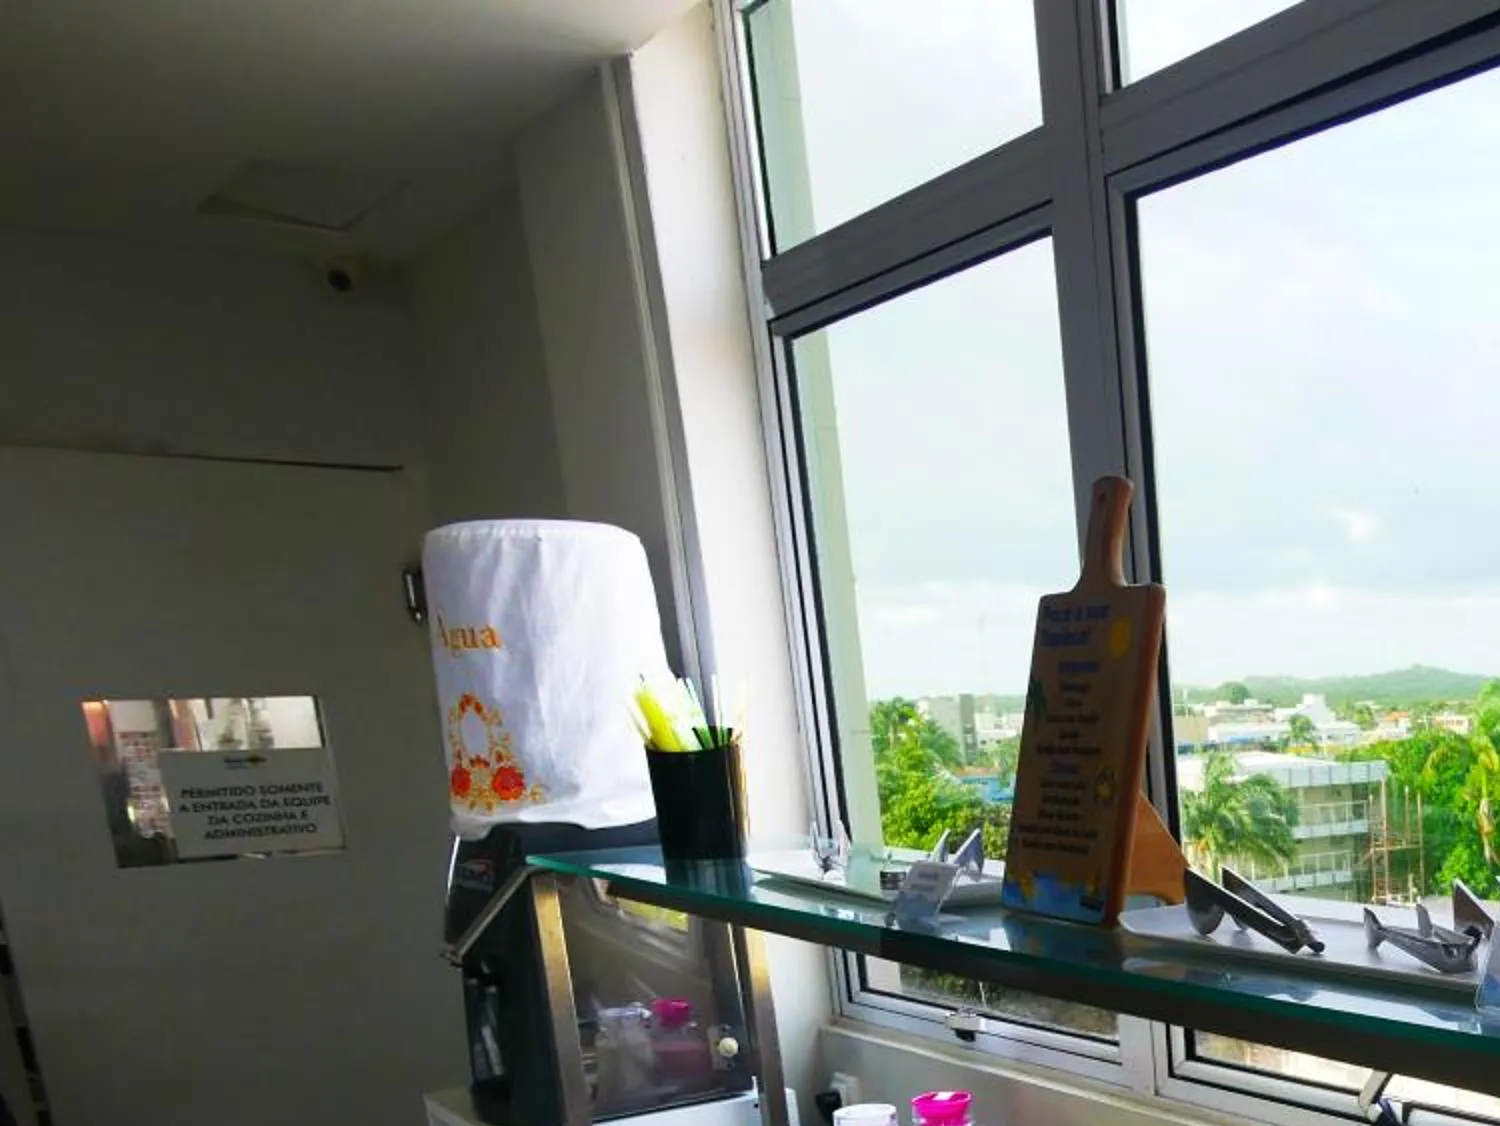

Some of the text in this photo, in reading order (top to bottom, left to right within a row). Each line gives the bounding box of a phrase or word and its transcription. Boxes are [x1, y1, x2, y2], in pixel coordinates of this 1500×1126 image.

[181, 782, 323, 798] PERMITIDO SOMENTE
[178, 795, 331, 813] A ENTRADA DA EQUIPE
[208, 811, 309, 826] DA COZINHA E
[205, 823, 318, 839] ADMINISTRATIVO
